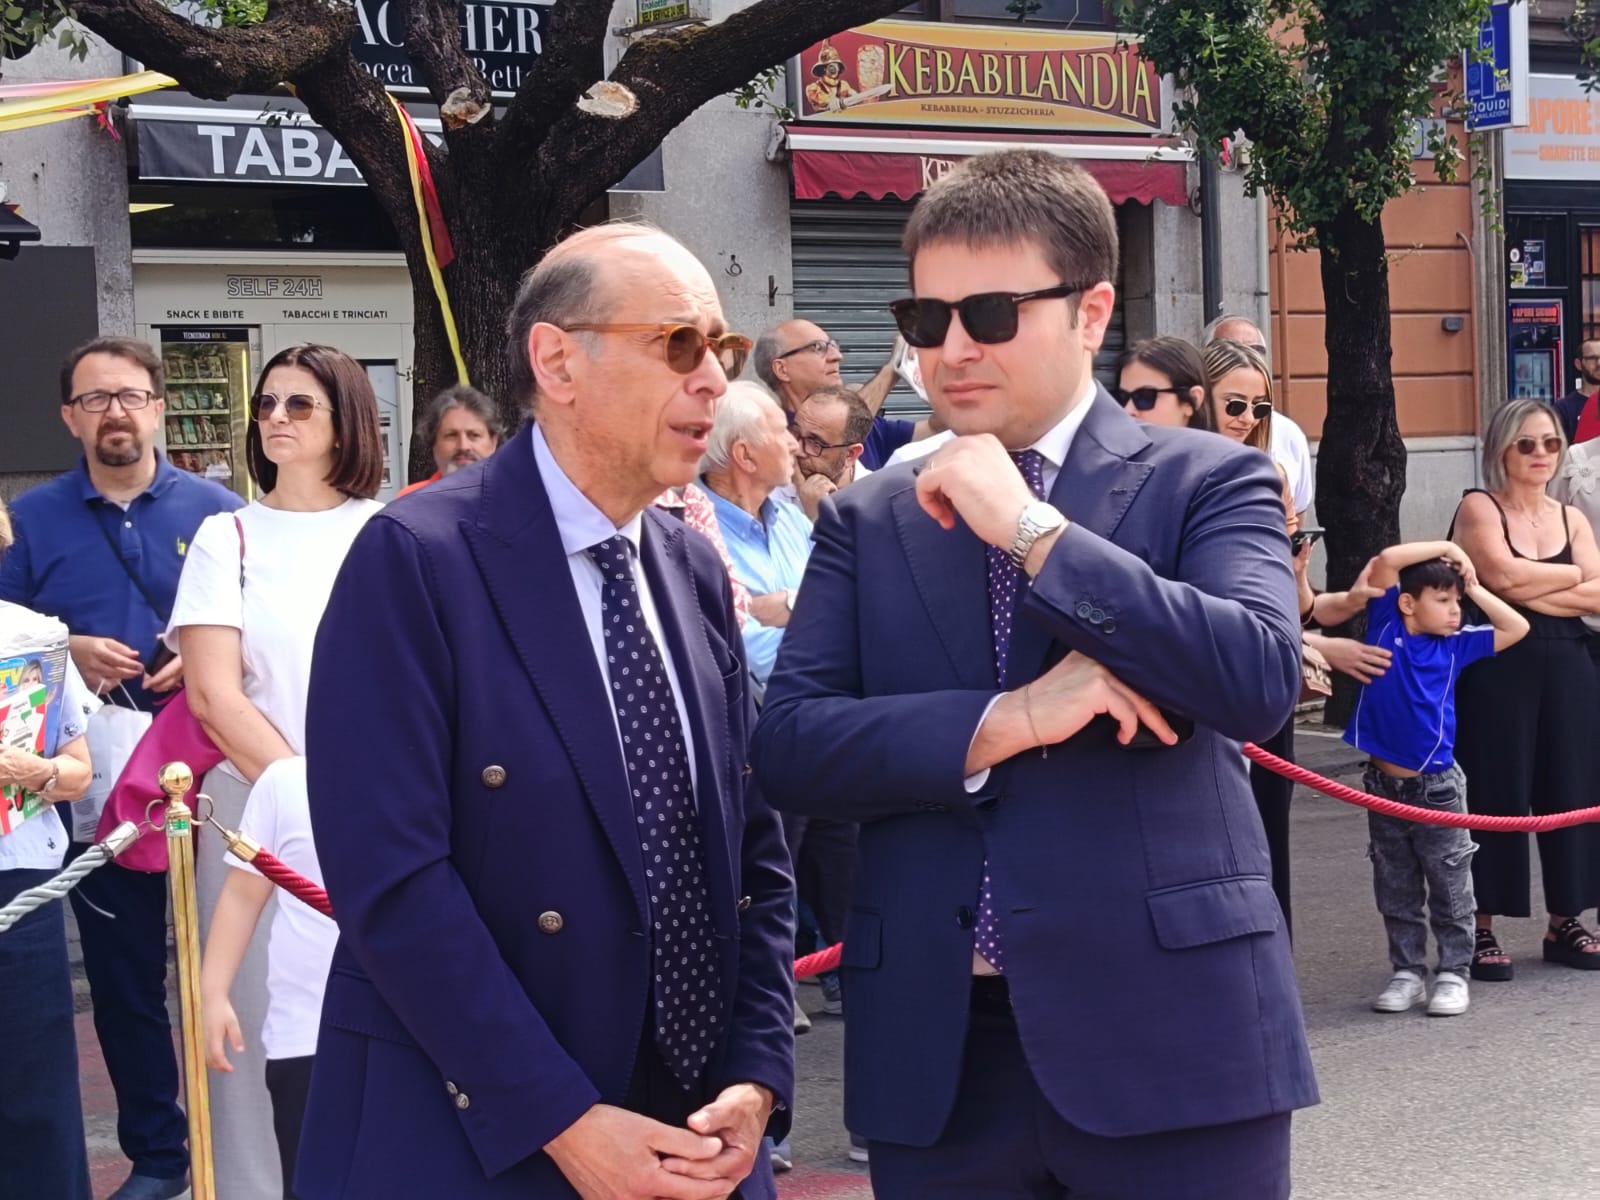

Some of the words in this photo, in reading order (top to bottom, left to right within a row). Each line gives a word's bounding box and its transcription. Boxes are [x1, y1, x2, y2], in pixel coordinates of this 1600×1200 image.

[885, 41, 1156, 122] KEBABILANDIA
[920, 103, 978, 114] KEBABBERIA
[986, 106, 1055, 116] STUZZICHERIA
[1513, 97, 1592, 134] APORE
[197, 125, 443, 178] TABA
[227, 278, 278, 296] SELF
[283, 278, 323, 296] 24H
[166, 310, 200, 319] SNACK
[203, 310, 209, 319] E
[212, 310, 245, 319] BIBITE
[282, 310, 331, 319] TABACCHI
[333, 310, 339, 319] E
[342, 310, 388, 319] TRINCIATI
